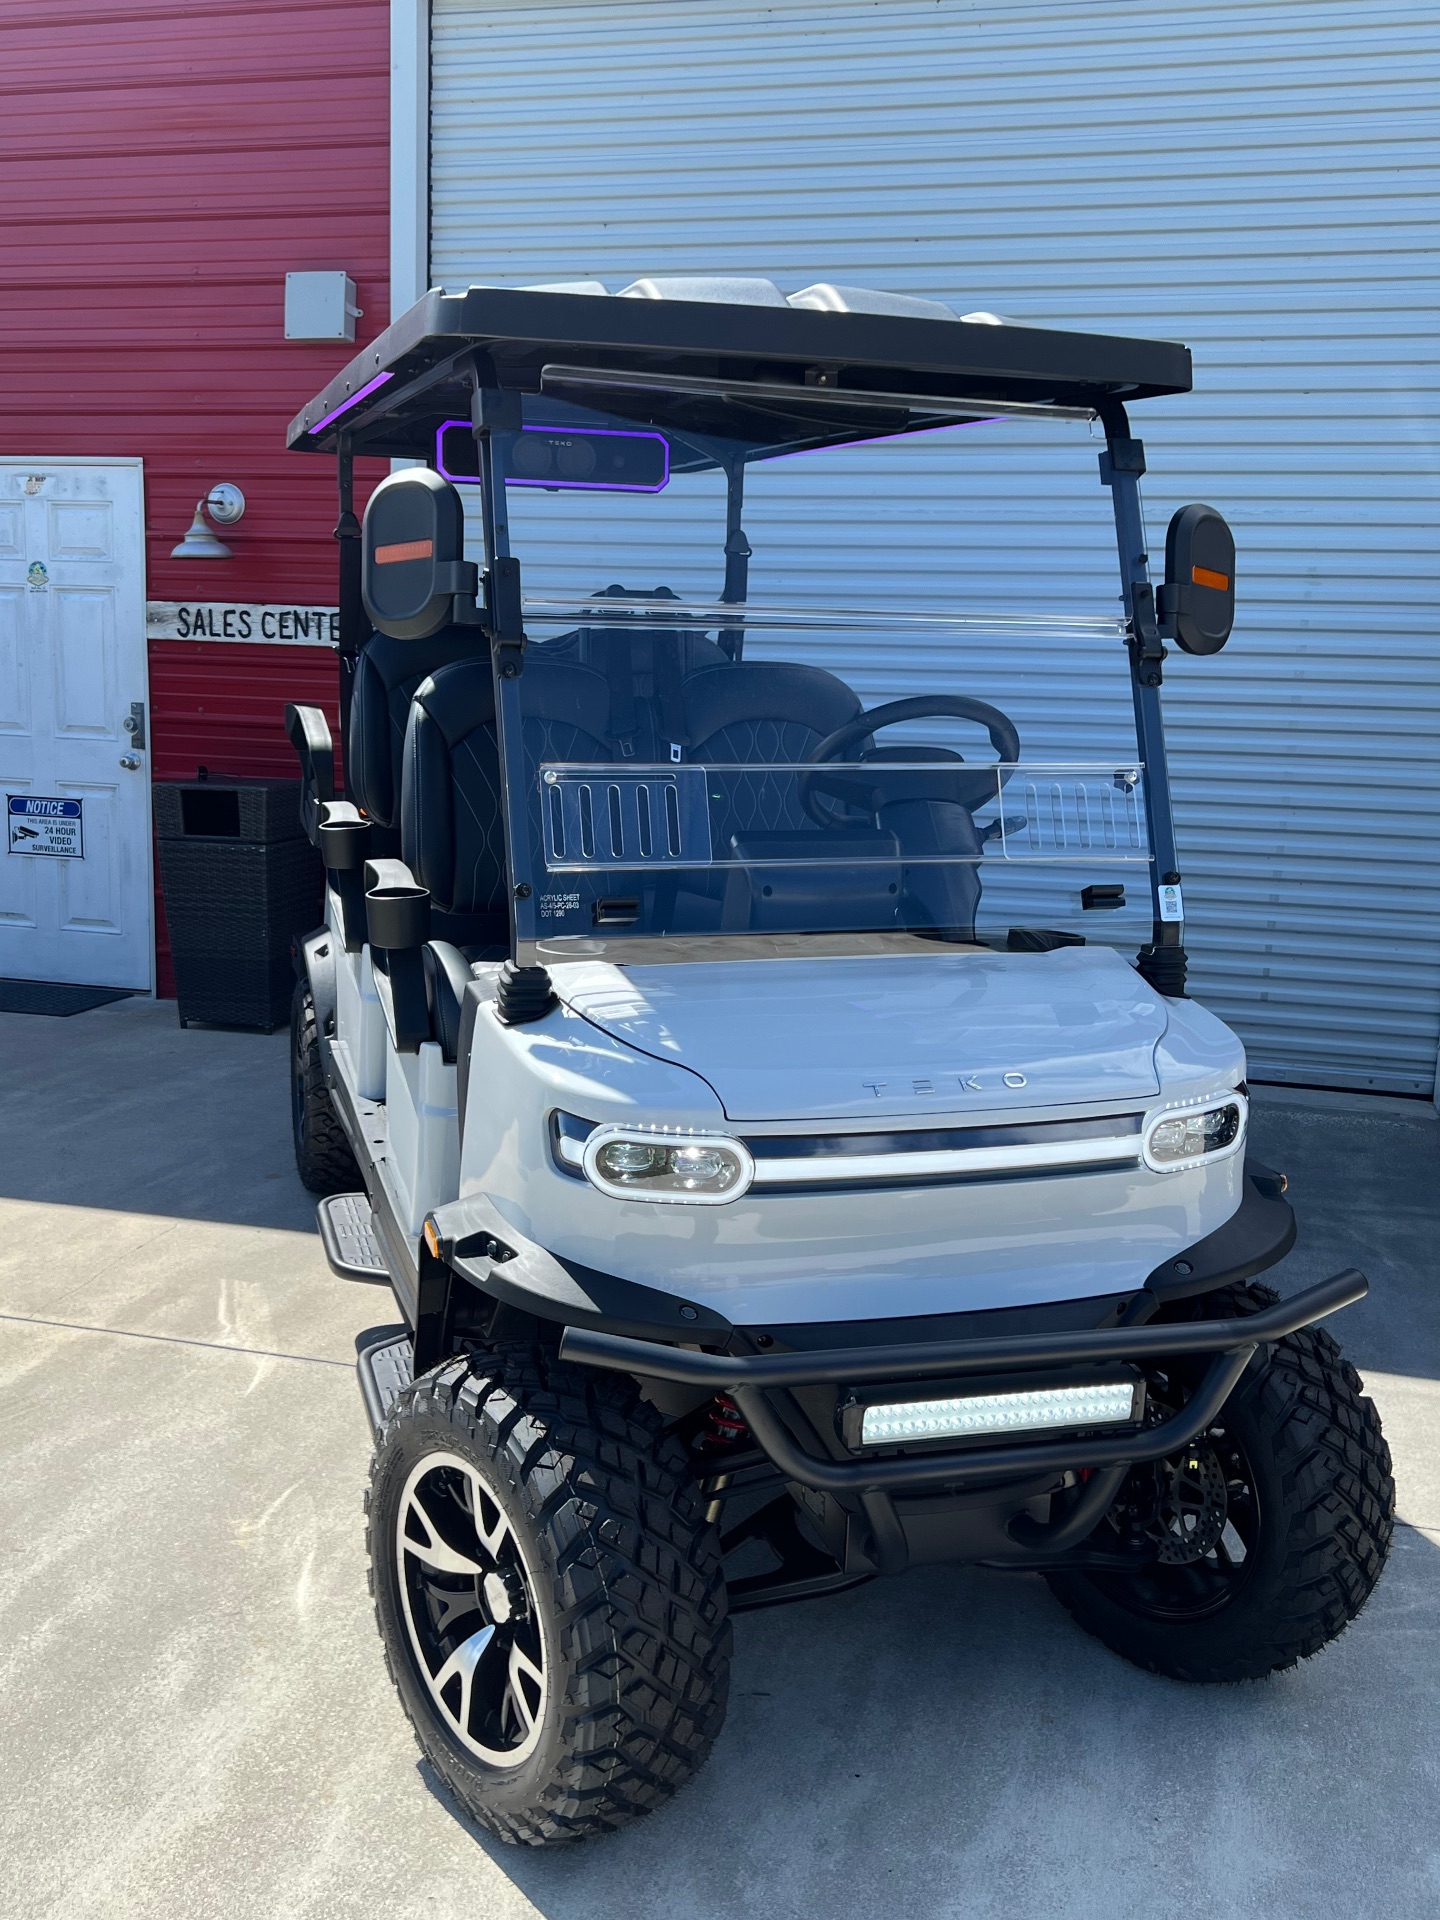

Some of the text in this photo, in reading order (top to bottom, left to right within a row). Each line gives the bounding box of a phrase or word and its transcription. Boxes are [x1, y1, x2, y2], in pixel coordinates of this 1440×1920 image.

[177, 607, 341, 642] SALES CENTE
[26, 800, 65, 815] NOTICE
[44, 826, 76, 836] 24 HOUR
[49, 836, 72, 845] VIDEO
[32, 844, 76, 854] SURVEILLANCE
[540, 910, 552, 918] DOT
[862, 1072, 1028, 1098] TEKO
